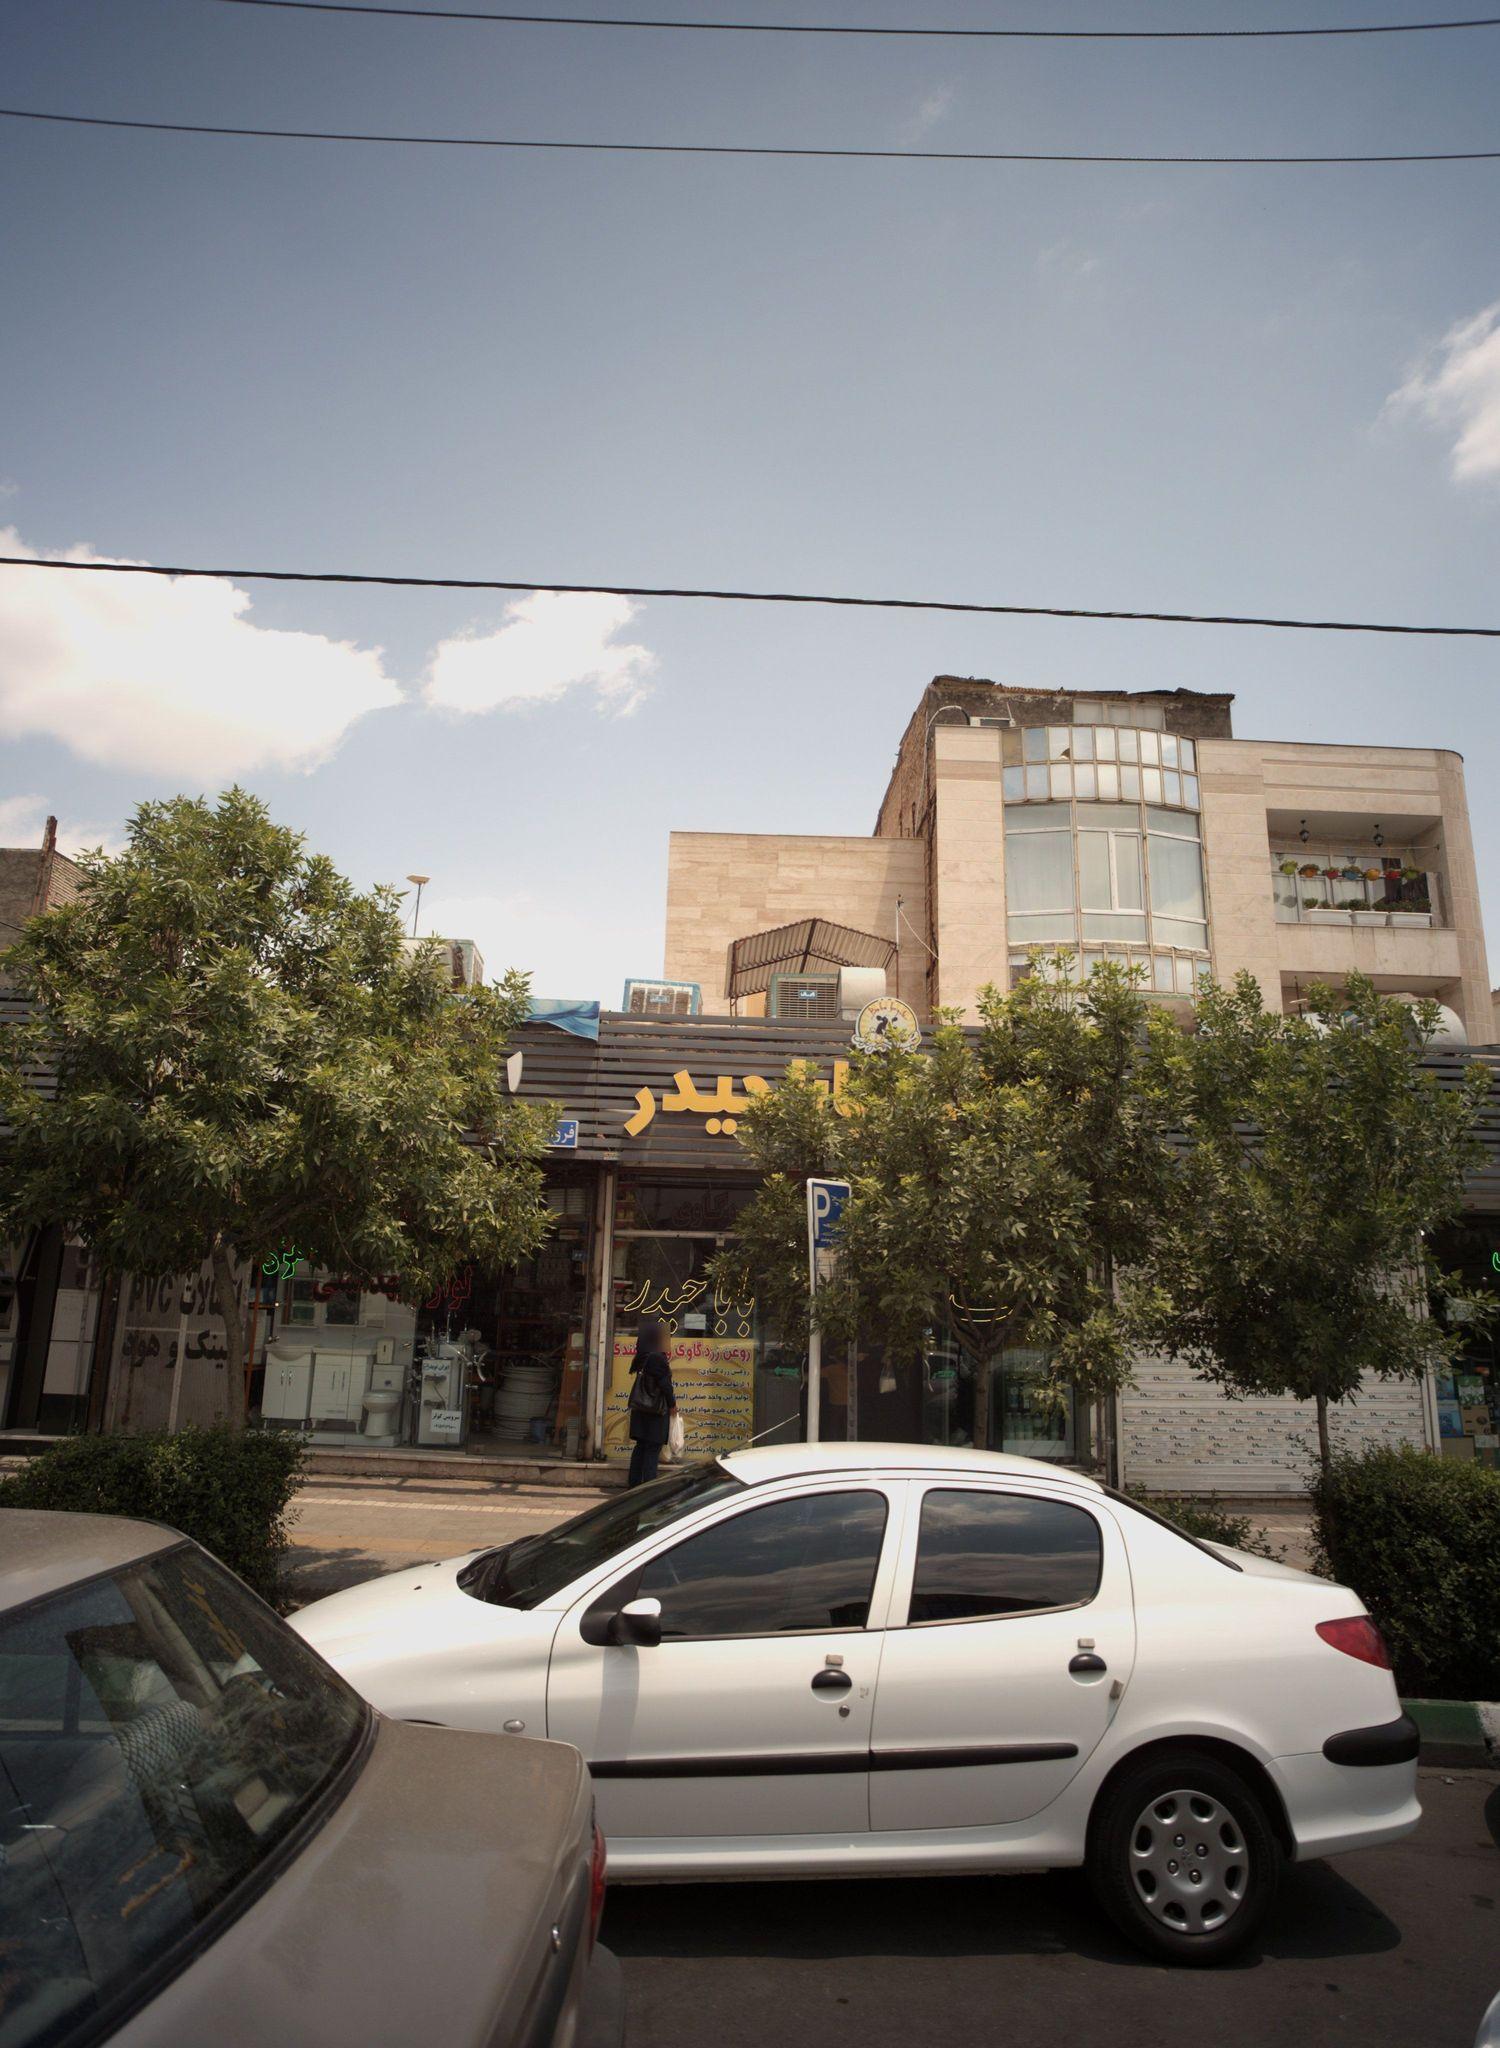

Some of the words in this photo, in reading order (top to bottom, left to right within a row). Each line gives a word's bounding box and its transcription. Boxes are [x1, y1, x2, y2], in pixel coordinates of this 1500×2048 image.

[624, 1069, 780, 1137] حیدر
[813, 1186, 831, 1239] P
[129, 1273, 173, 1313] PVC
[623, 1278, 707, 1335] حیدر
[186, 1329, 228, 1369] ینک
[675, 1341, 703, 1361] گاوی
[704, 1346, 720, 1362] زرد
[723, 1345, 751, 1362] روغن
